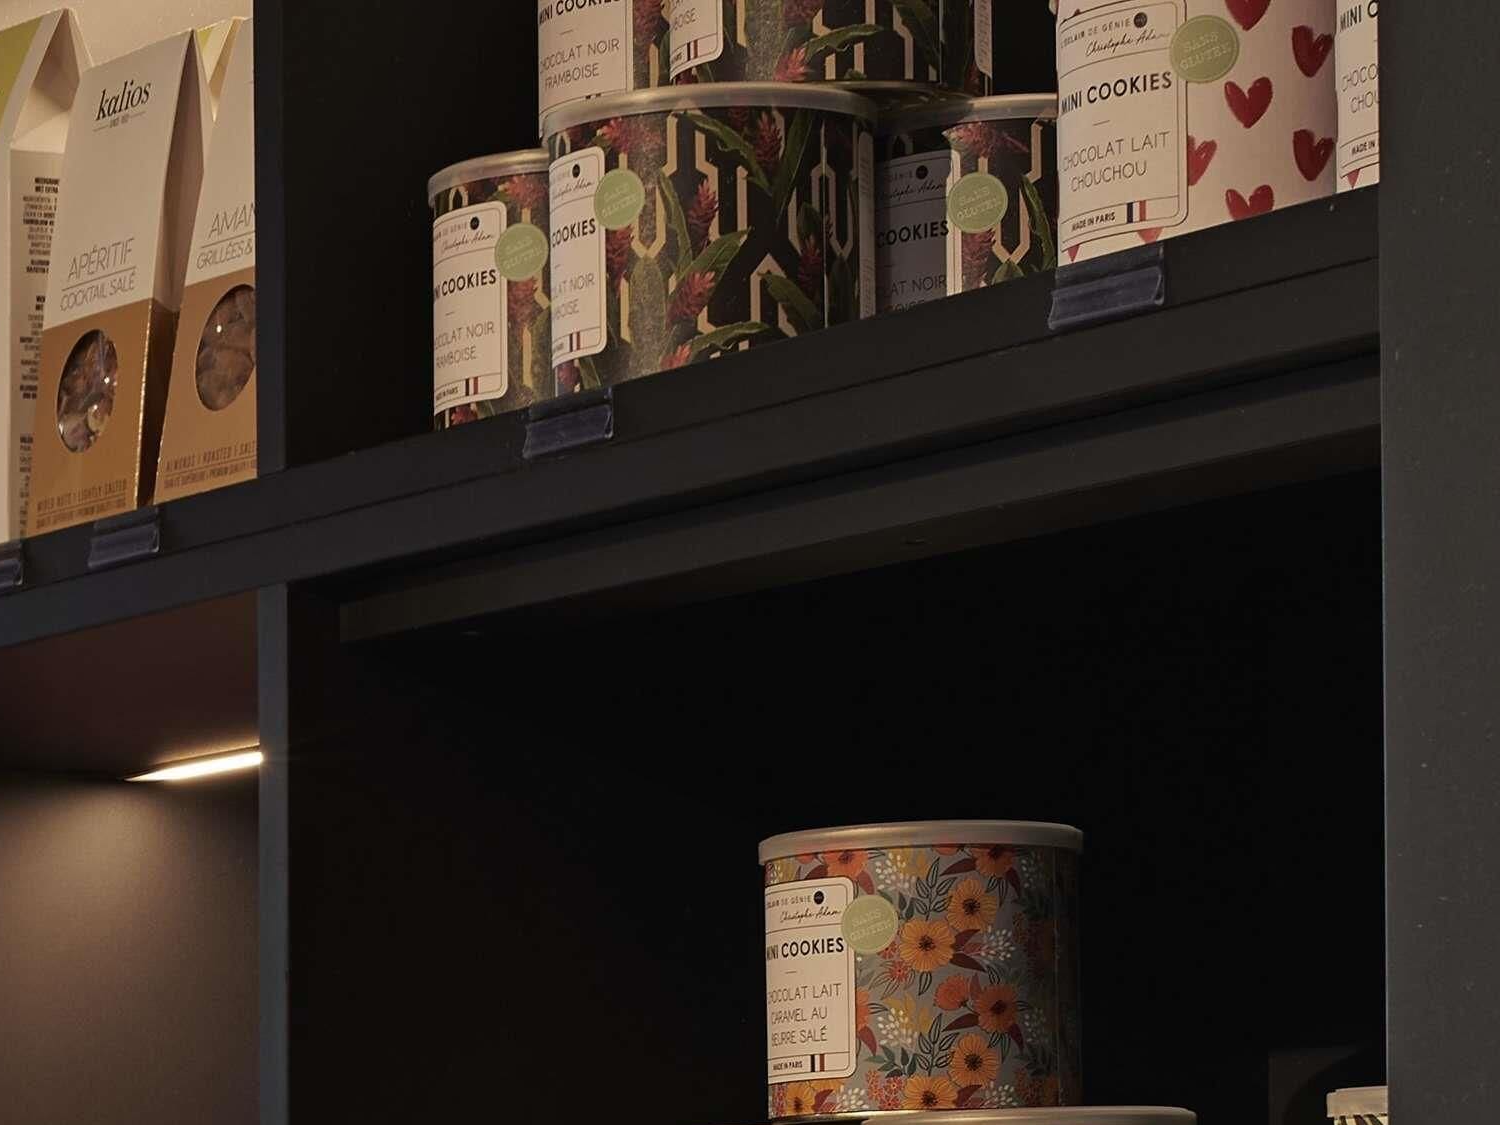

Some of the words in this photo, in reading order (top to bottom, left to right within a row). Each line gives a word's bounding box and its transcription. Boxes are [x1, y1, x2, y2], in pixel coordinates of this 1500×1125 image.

[1088, 27, 1098, 36] DE
[1102, 19, 1131, 33] GÉNIE
[1340, 5, 1362, 33] MINI
[587, 38, 620, 55] NOIR
[1085, 33, 1133, 57] Christophe
[95, 79, 152, 121] kalios
[1061, 90, 1082, 114] MINI
[1087, 71, 1172, 104] COOKIES
[1062, 138, 1125, 172] CHOCOLAT
[1131, 131, 1171, 152] LAIT
[1071, 159, 1148, 193] CHOUCHOU
[551, 218, 597, 248] COOKIES
[877, 220, 949, 248] COOKIES
[1072, 219, 1087, 232] MADE
[1095, 211, 1116, 224] PARIS
[67, 237, 135, 280] APÉRITIF
[108, 271, 136, 297] SALÉ
[441, 269, 497, 297] COOKIES
[911, 274, 947, 293] NOIR
[466, 321, 495, 338] NOIR
[781, 937, 845, 958] COOKIES
[812, 983, 842, 999] LAIT
[811, 1005, 828, 1020] AU
[799, 1025, 828, 1043] SALÉ
